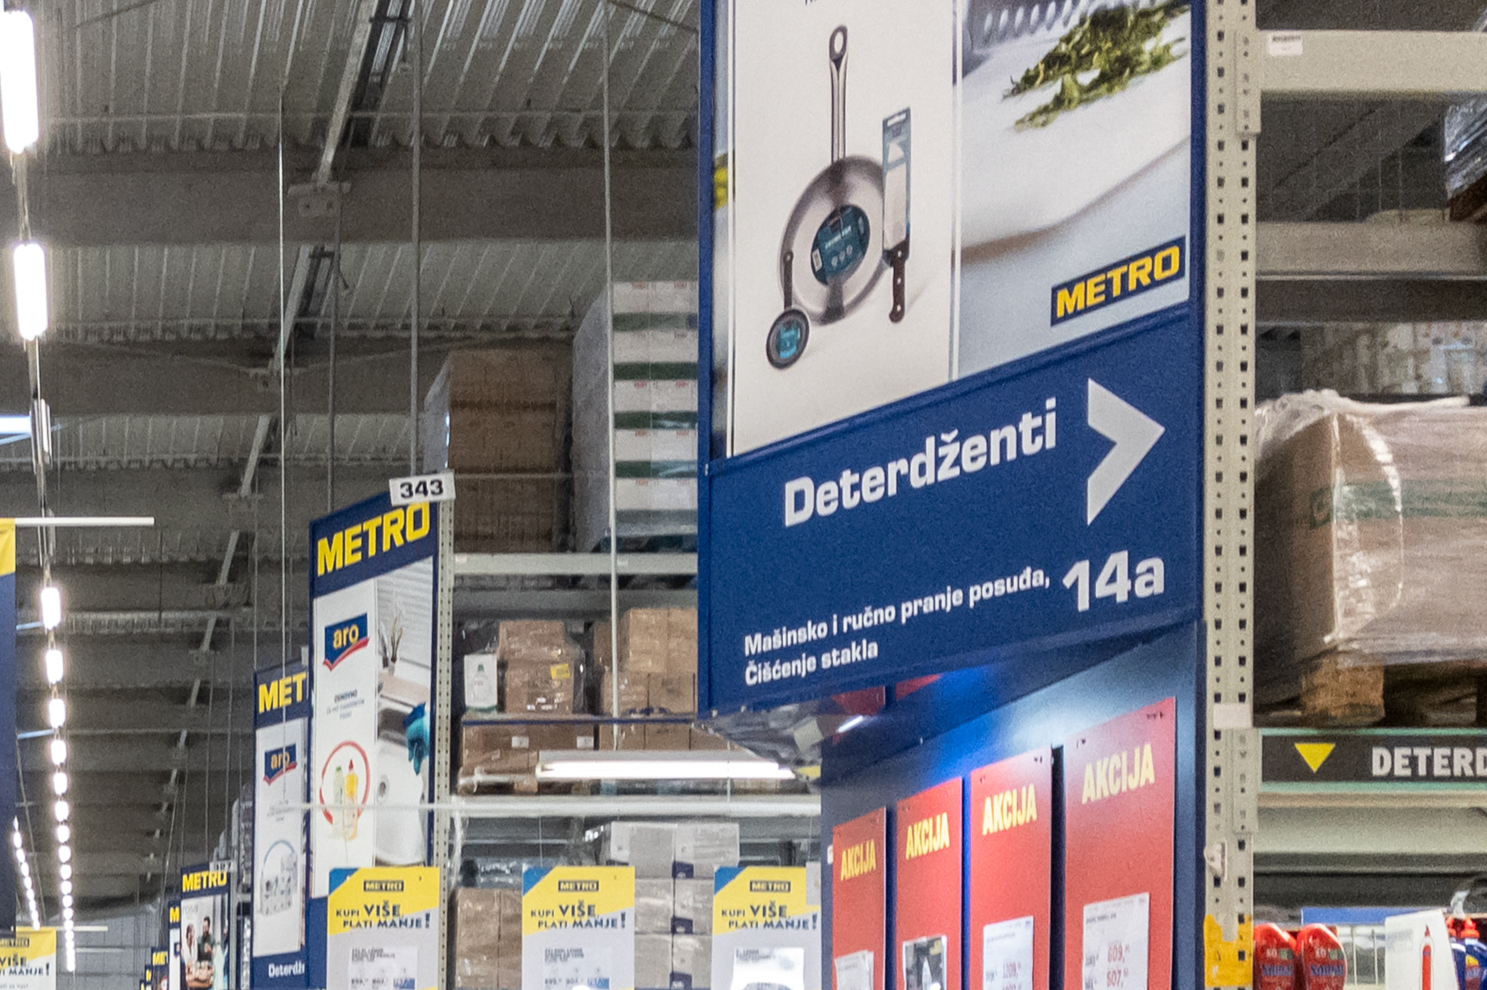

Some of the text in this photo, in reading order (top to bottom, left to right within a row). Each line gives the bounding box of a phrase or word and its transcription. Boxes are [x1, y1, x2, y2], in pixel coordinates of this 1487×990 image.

[1057, 246, 1180, 318] METRO
[785, 397, 1056, 527] Deterdženti
[400, 479, 443, 500] 343
[317, 500, 430, 577] METRO
[744, 620, 827, 657] Mašinsko
[833, 615, 838, 635] i
[842, 602, 896, 633] ručno
[901, 585, 963, 626] pranje
[1062, 550, 1165, 612] 14a
[333, 624, 359, 649] aro
[745, 639, 879, 686] Čišćenje stakla
[1082, 744, 1155, 804] AKCIJA
[982, 784, 1037, 835] AKCIJA
[906, 812, 950, 859] AKCIJA
[840, 839, 876, 881] AKCIJA
[182, 871, 227, 892] METRO
[336, 909, 360, 918] KUPI
[342, 912, 430, 929] PLATI MANJE!
[530, 909, 555, 918] KUPI
[538, 912, 626, 930] PLATI MANJE!
[721, 909, 746, 918] KUPI
[728, 912, 818, 930] PLATI MANJE!
[268, 962, 305, 978] Deterdž
